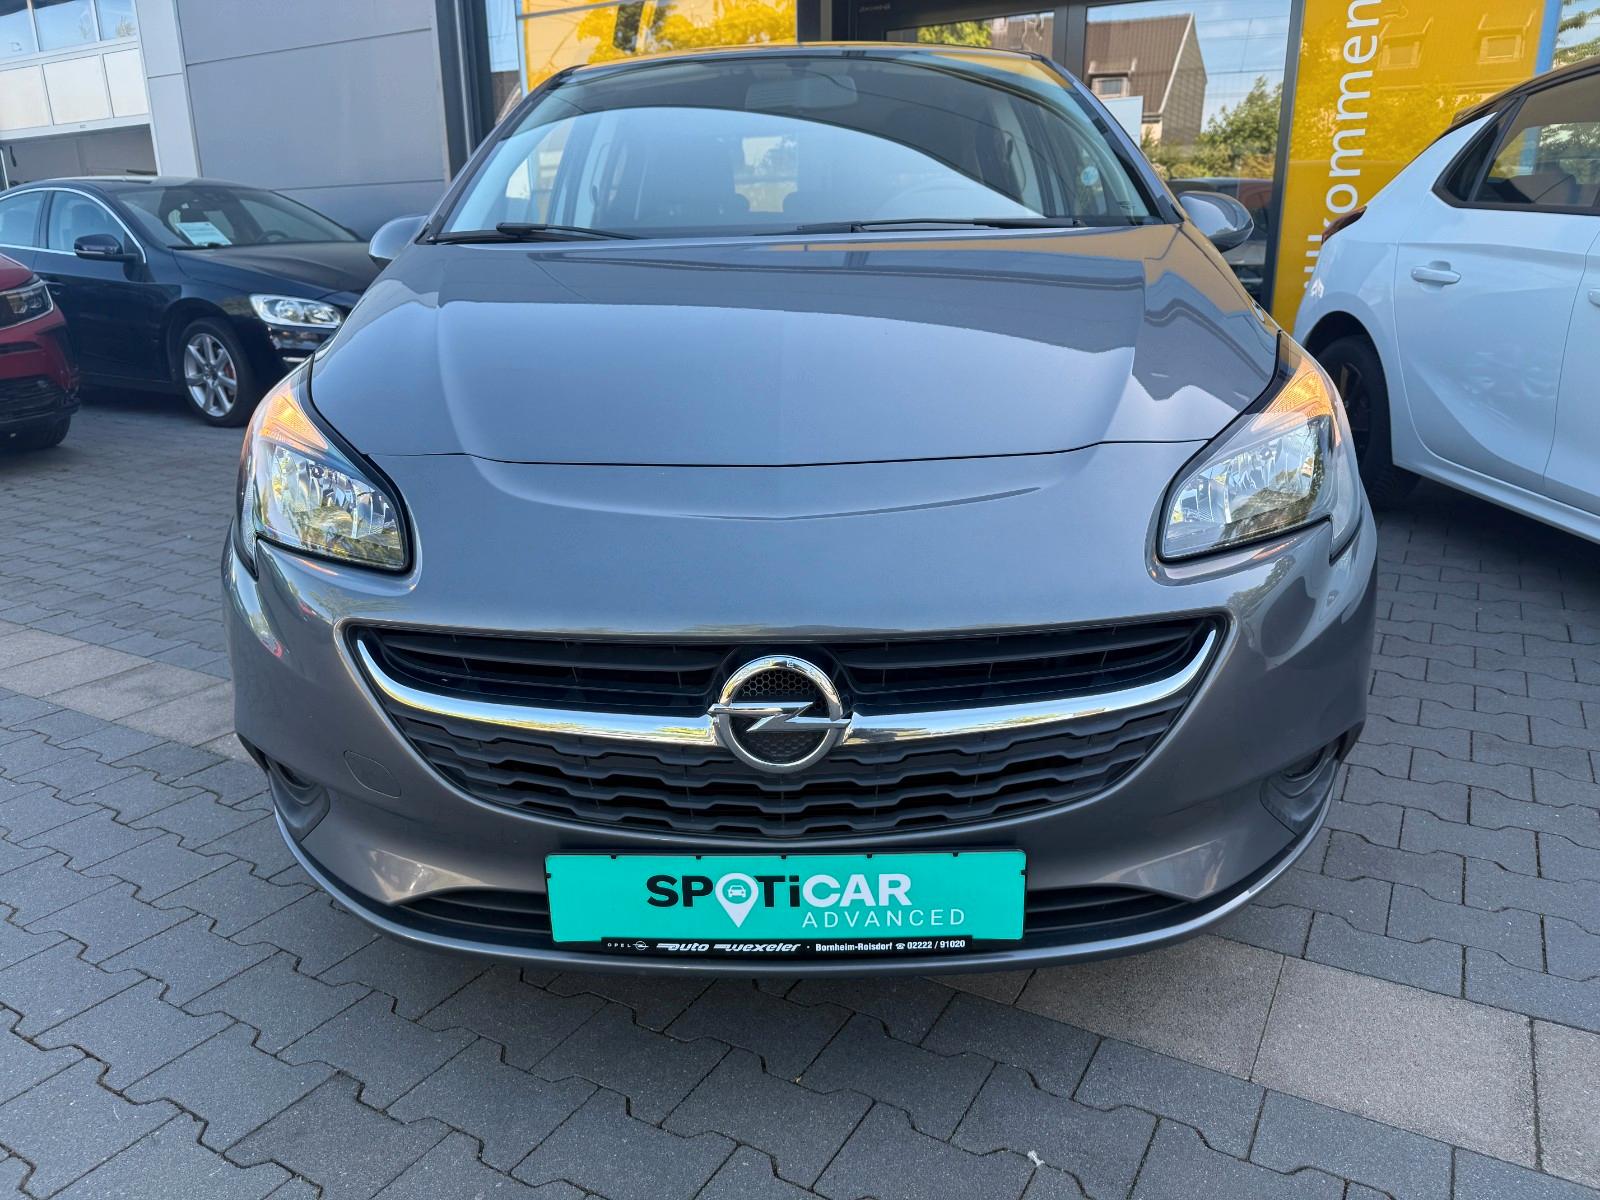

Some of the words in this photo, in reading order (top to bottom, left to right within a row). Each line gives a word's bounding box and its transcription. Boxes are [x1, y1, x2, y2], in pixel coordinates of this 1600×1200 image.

[802, 908, 965, 928] ADVANCED
[907, 941, 933, 949] 02222
[939, 939, 966, 949] 91020
